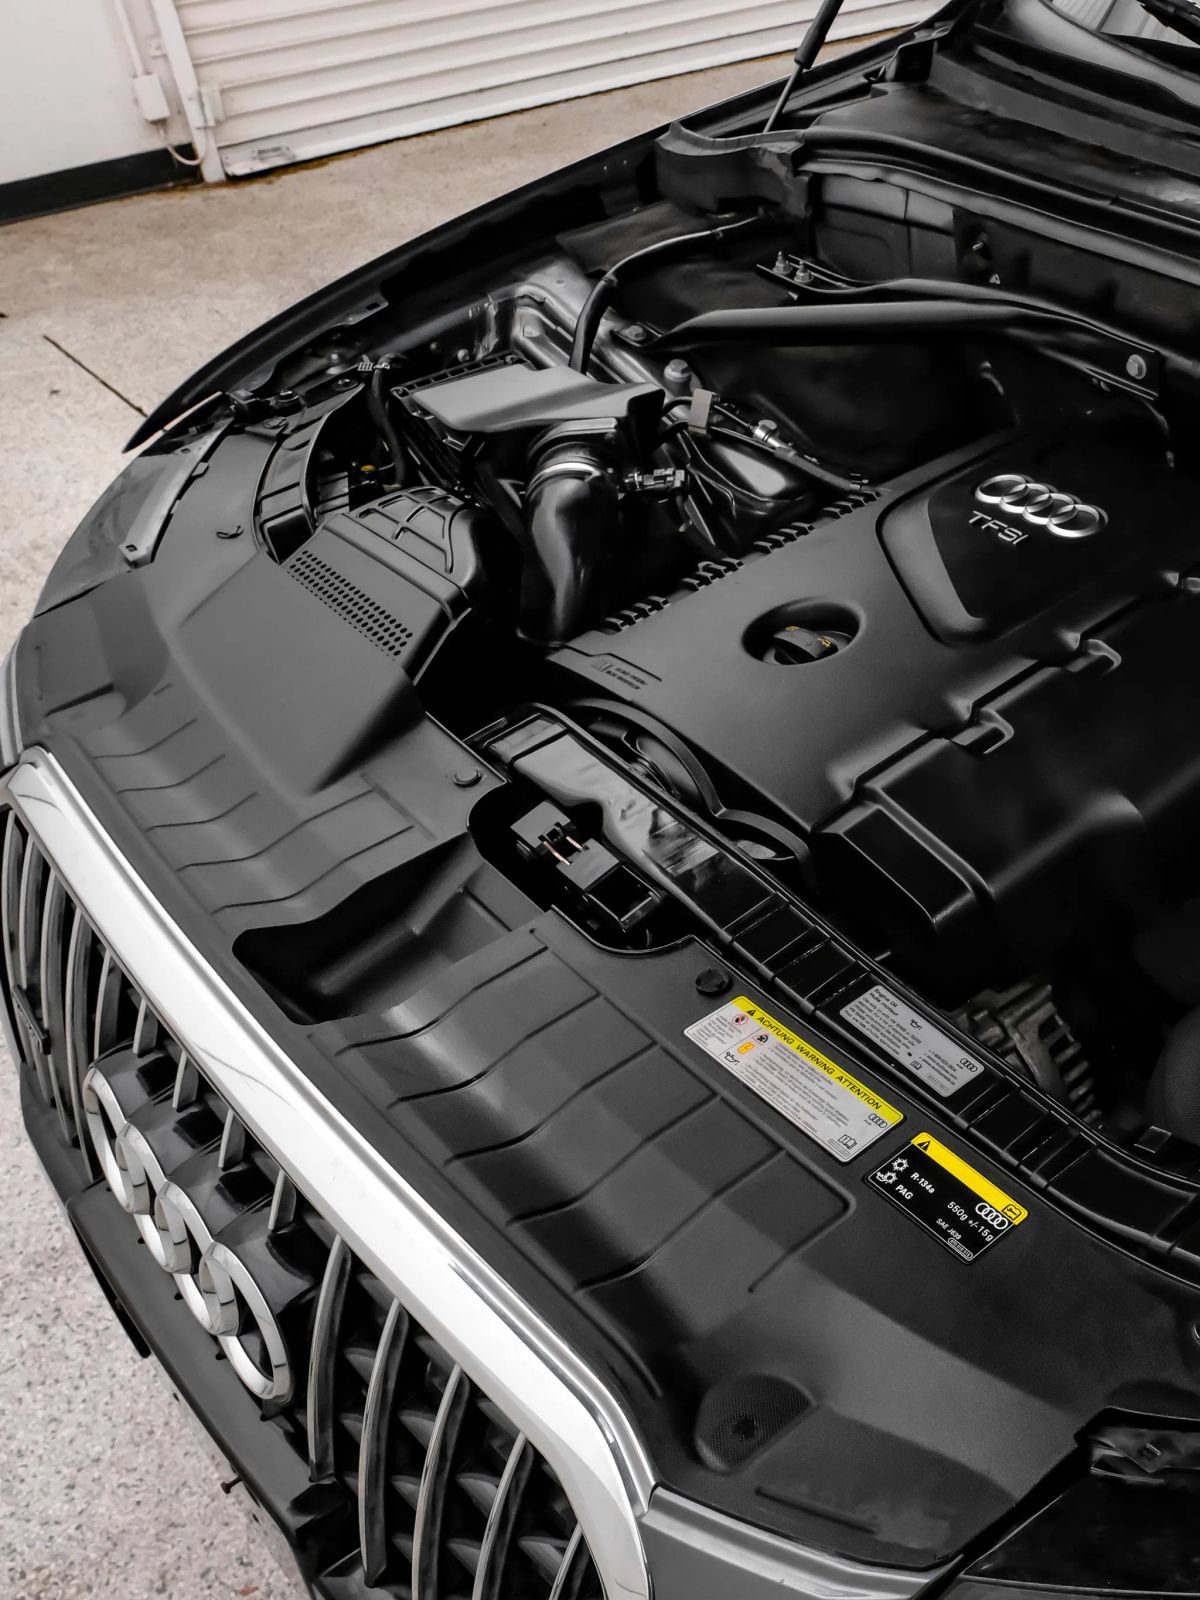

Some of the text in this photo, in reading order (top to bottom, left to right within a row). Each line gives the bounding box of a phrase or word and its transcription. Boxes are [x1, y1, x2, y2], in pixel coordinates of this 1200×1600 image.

[968, 510, 1029, 545] TFSI
[758, 1016, 795, 1045] ACHTUNG
[796, 1043, 835, 1075] WARNING
[836, 1075, 882, 1110] ATTENTION
[895, 1184, 914, 1200] PAG
[910, 1172, 936, 1194] R-134a
[947, 1201, 968, 1221] 550g
[935, 1218, 949, 1230] SAE
